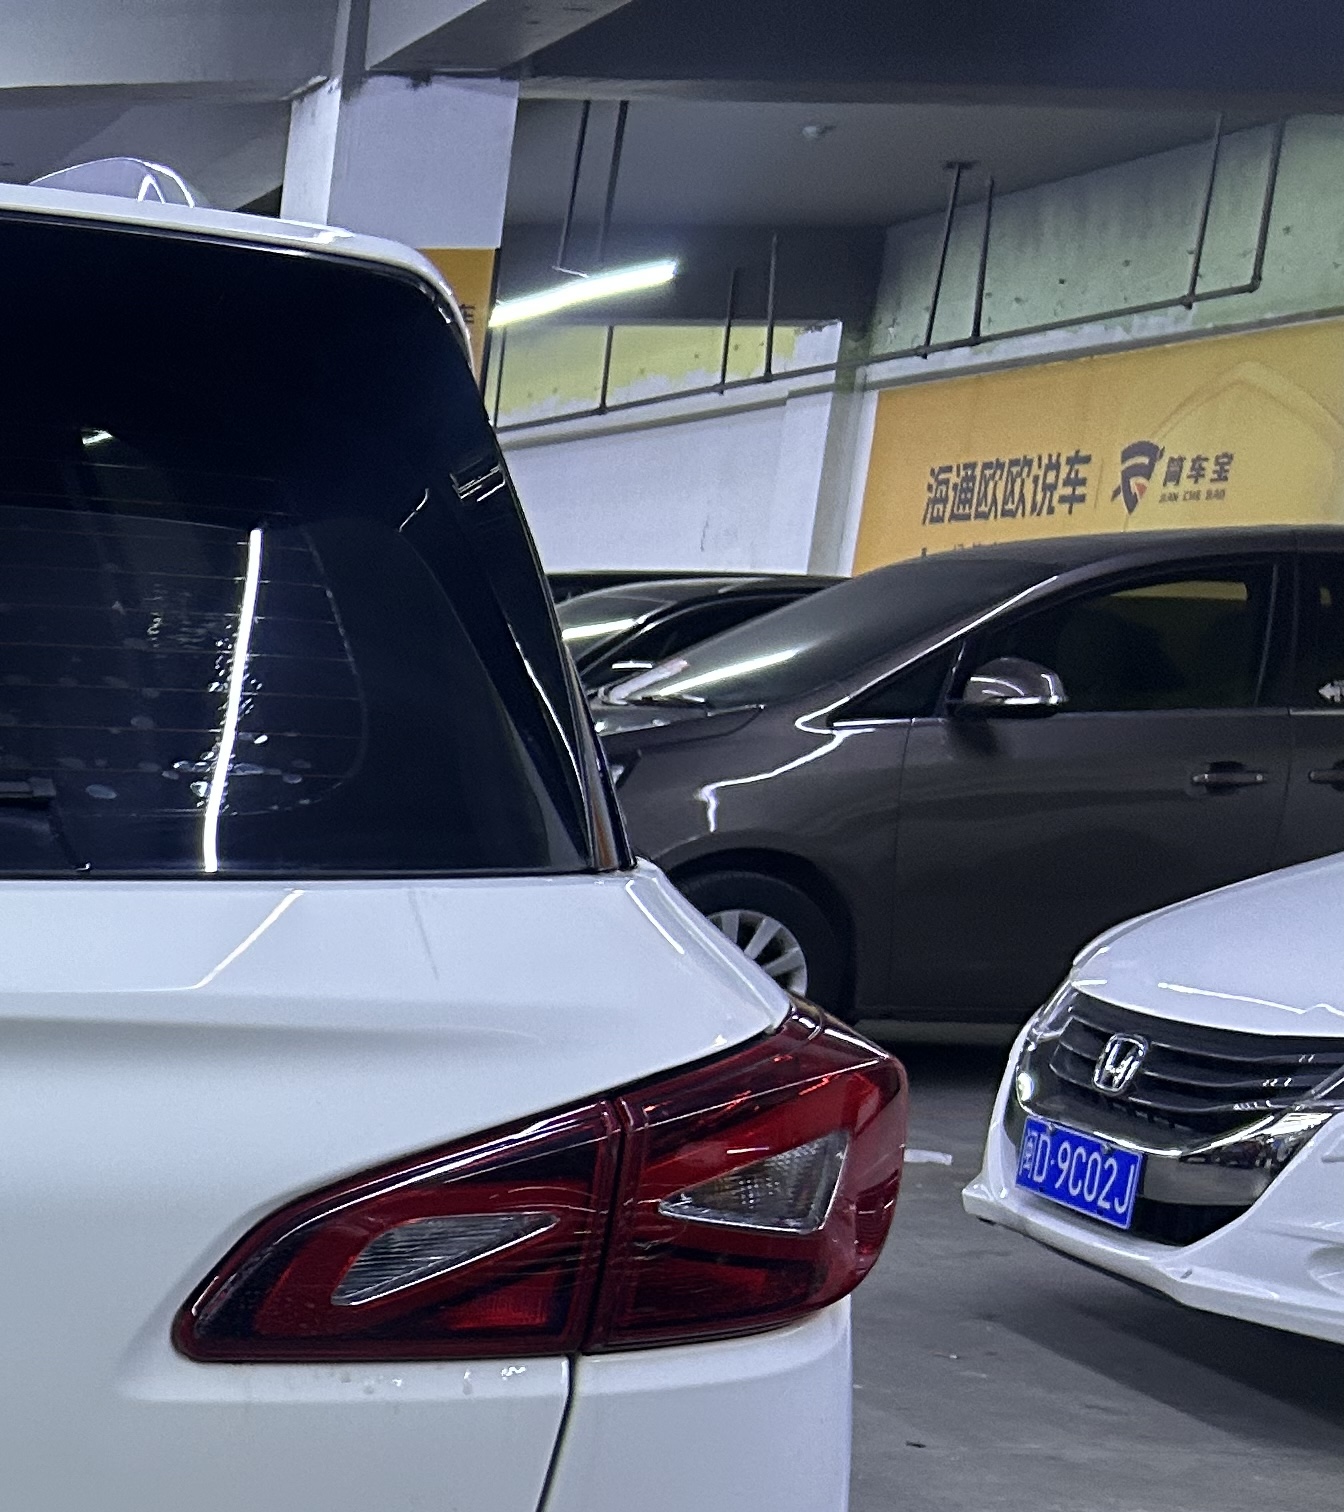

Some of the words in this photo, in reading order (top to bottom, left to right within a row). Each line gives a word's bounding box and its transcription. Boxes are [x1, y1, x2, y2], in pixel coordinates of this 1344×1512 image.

[922, 449, 1092, 526] 海通欧欧说车
